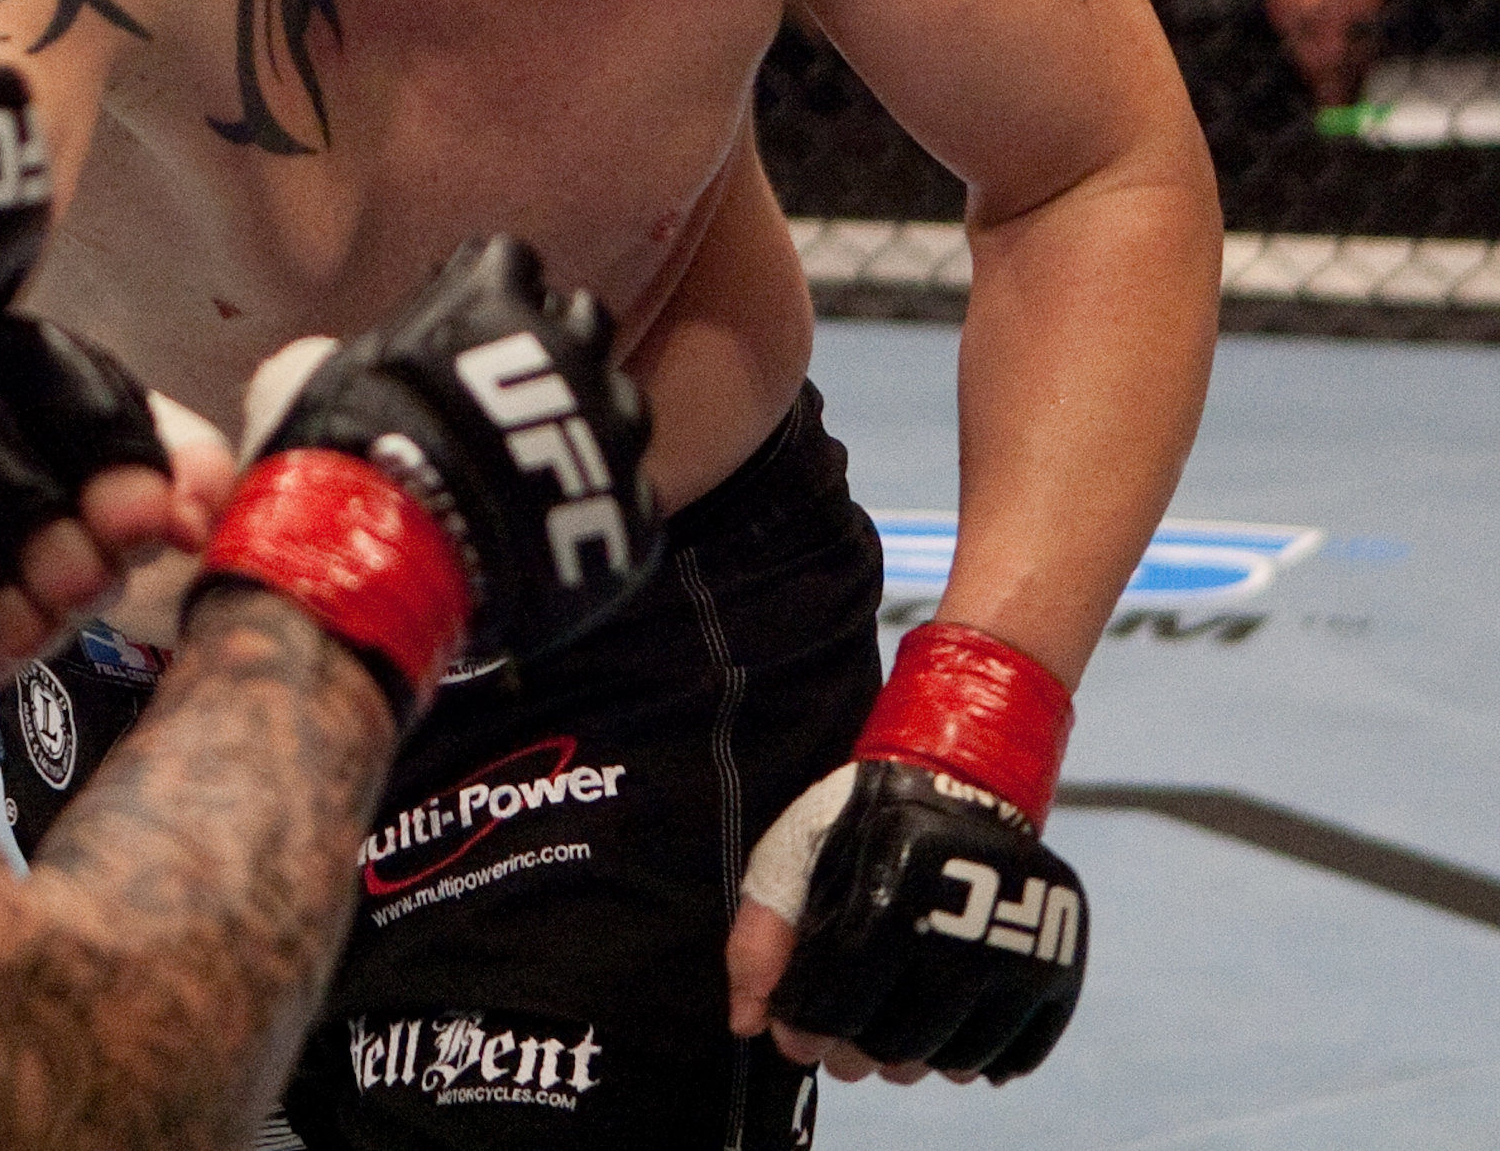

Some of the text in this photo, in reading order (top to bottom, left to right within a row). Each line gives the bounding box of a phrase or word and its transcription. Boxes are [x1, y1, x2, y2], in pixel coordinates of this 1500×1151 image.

[456, 331, 630, 588] UFC
[357, 764, 627, 866] ulti-Power
[371, 842, 591, 928] www.multipowerinc.com
[928, 858, 1080, 966] UFC
[421, 1010, 602, 1094] Bent
[436, 1087, 577, 1111] MOTORCYCLES.COM
